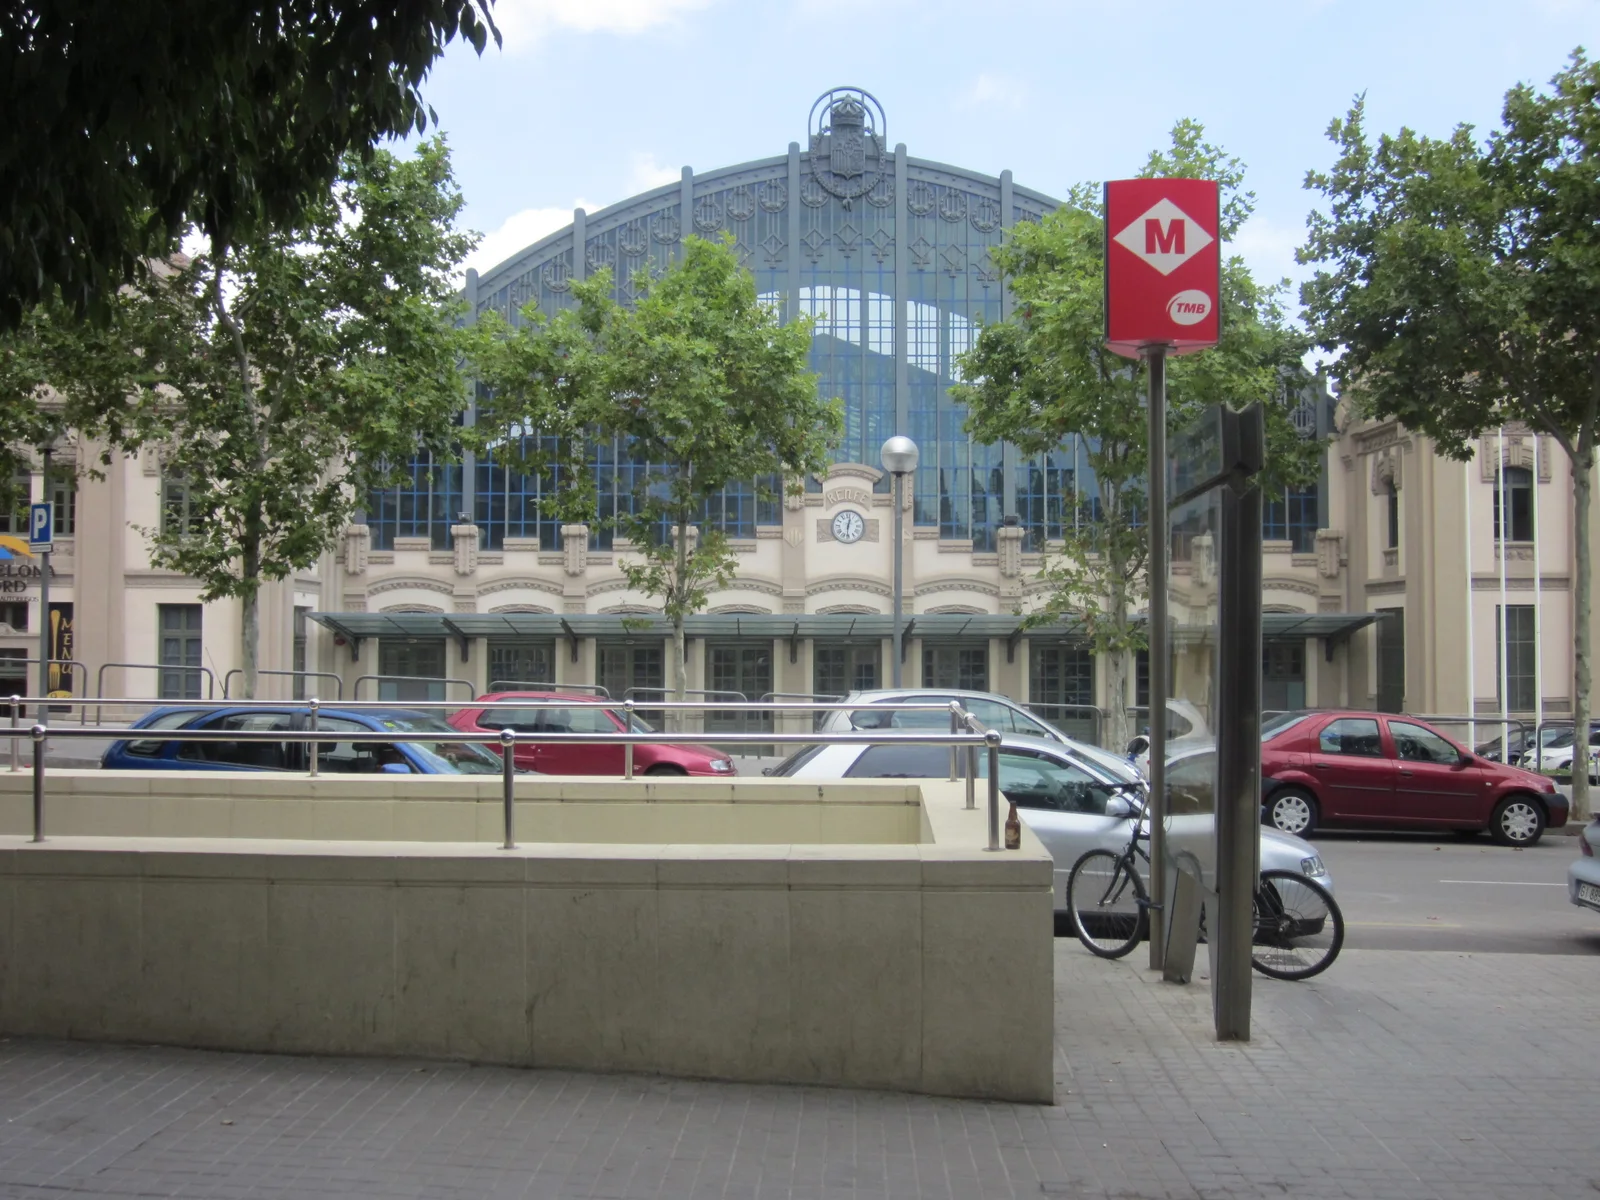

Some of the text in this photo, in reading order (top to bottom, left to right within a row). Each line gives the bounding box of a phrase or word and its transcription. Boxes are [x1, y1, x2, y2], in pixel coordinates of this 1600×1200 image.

[1145, 218, 1185, 254] M
[1176, 302, 1206, 314] TMB
[827, 488, 869, 504] RENFE
[33, 508, 47, 539] P
[0, 580, 27, 592] RD
